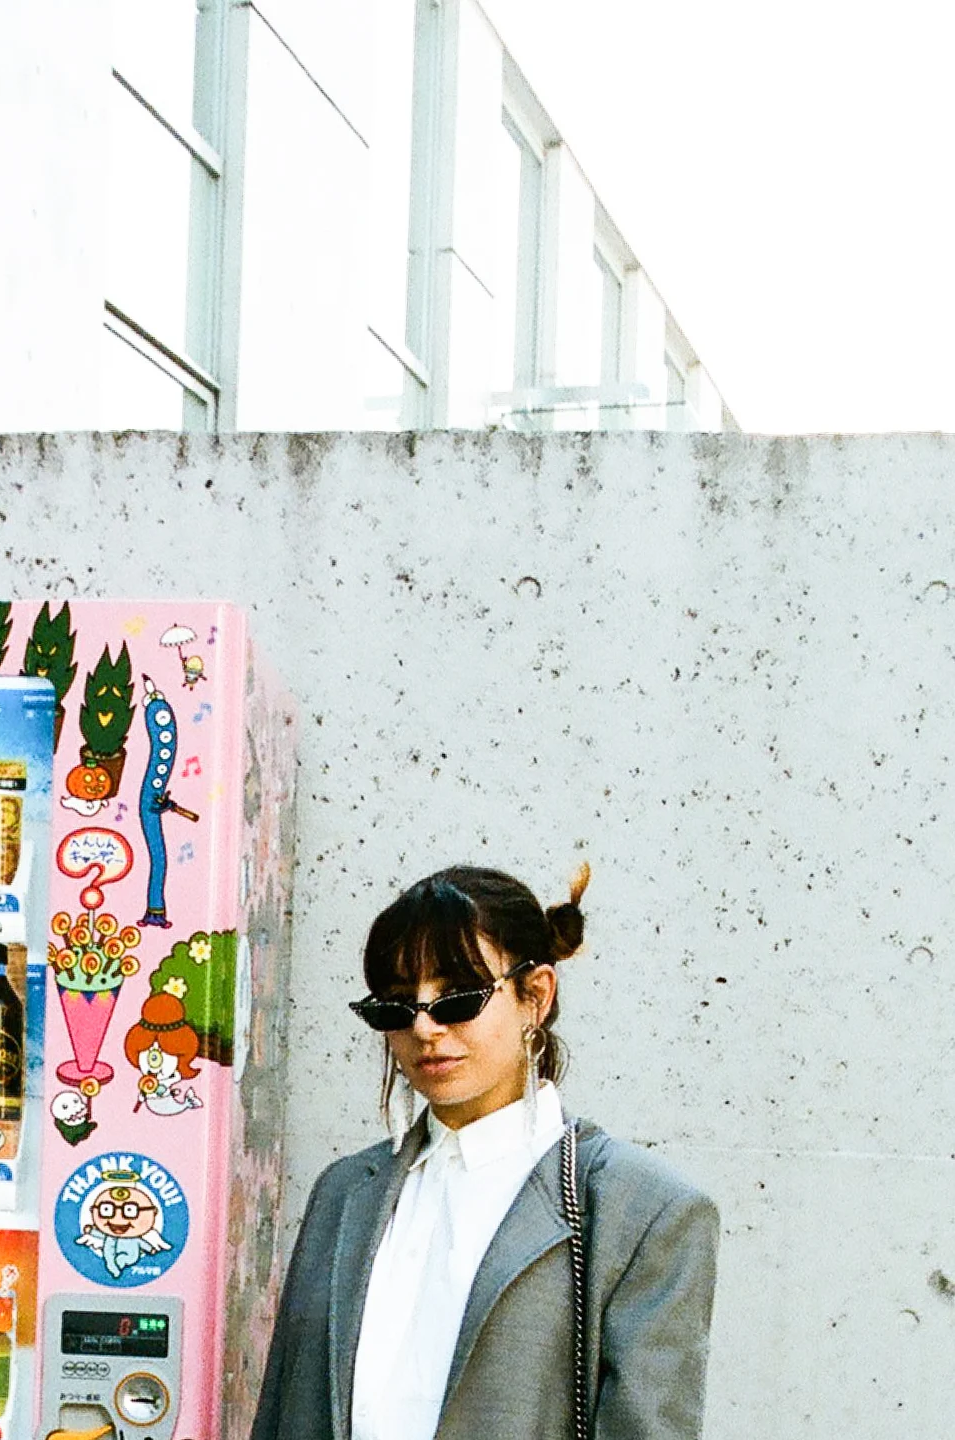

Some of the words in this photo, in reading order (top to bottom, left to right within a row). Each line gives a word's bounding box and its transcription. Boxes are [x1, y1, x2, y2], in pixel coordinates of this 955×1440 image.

[71, 836, 118, 850] へんしん
[70, 851, 124, 864] キャンディー
[62, 1156, 134, 1203] THANK
[140, 1160, 183, 1207] YOU!
